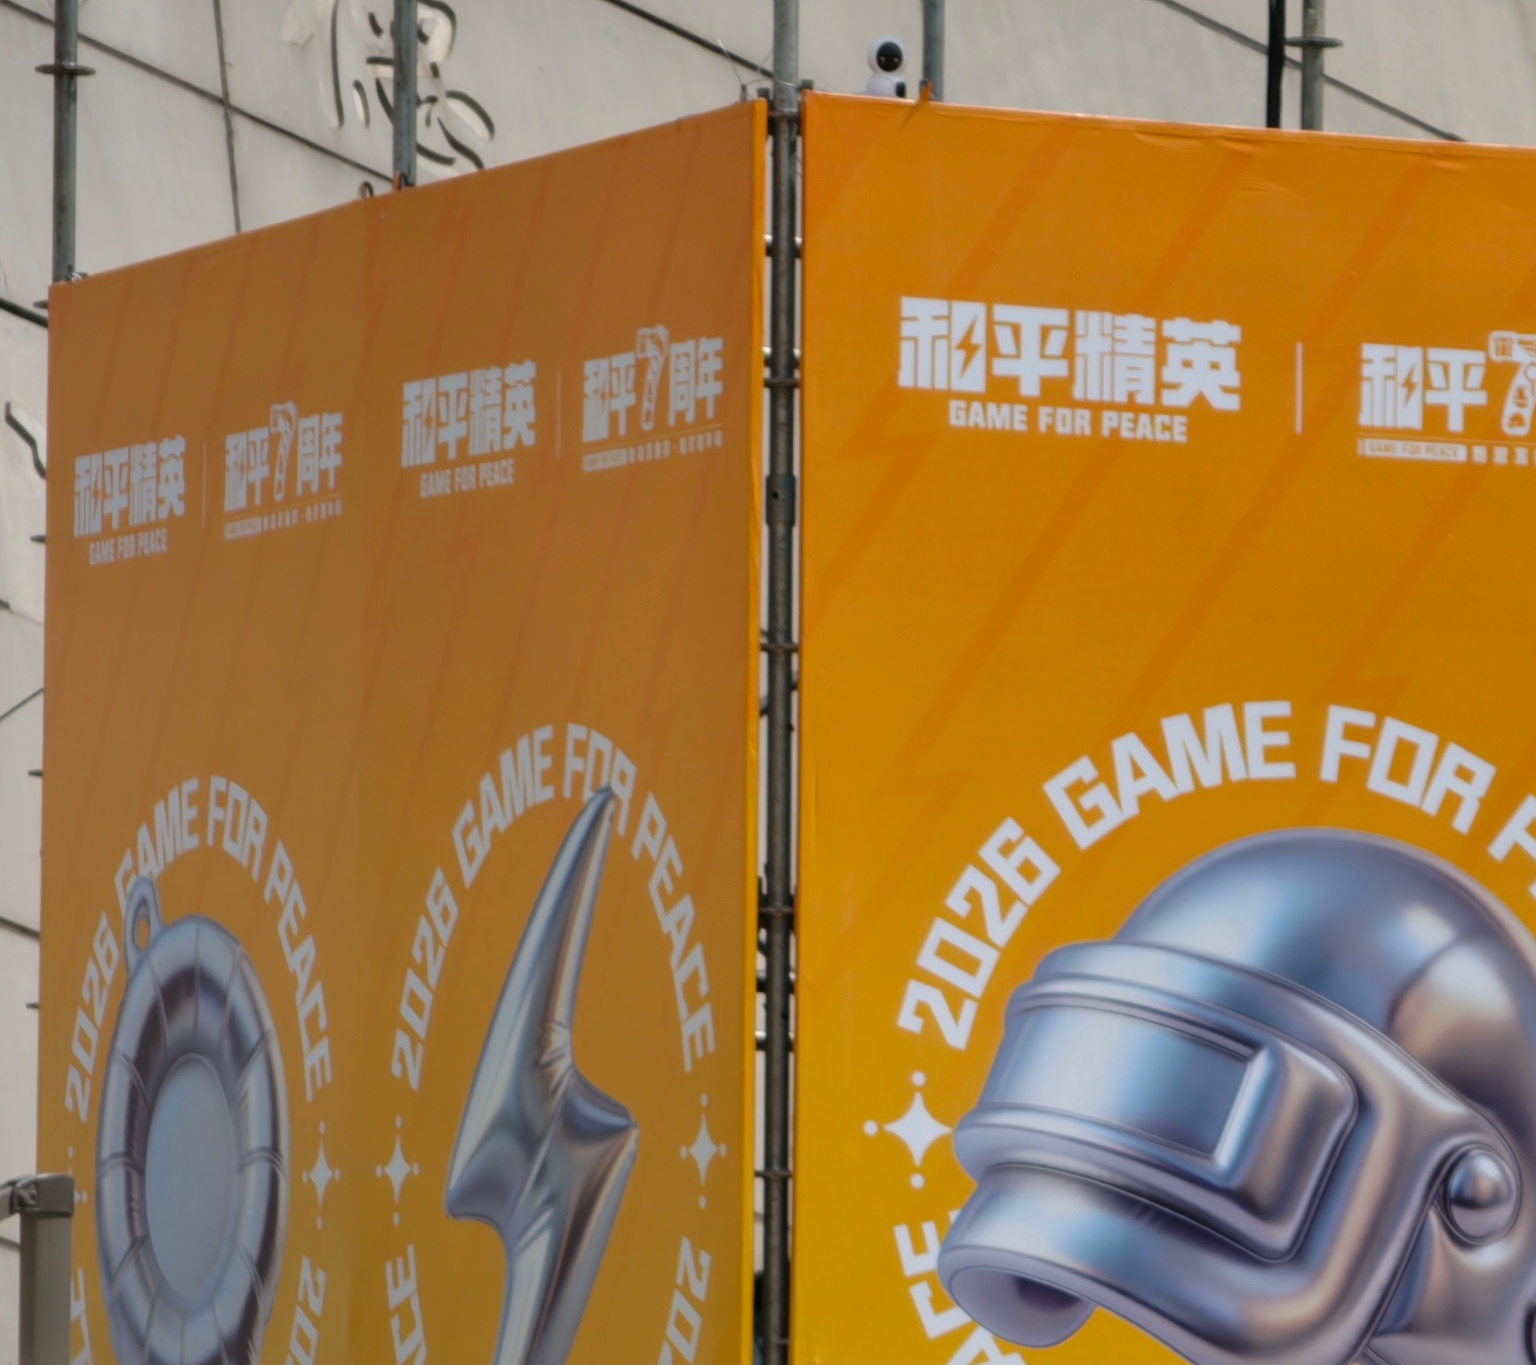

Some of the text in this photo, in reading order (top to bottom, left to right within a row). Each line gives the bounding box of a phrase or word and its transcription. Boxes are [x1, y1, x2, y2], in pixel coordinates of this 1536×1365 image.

[582, 324, 724, 443] 和平7周年
[898, 296, 1242, 412] 和平精英
[224, 400, 343, 513] 和平7周年
[401, 359, 536, 469] 和平精英
[949, 400, 1189, 443] GAME FOR PEACE
[73, 435, 186, 538] 和平精英
[420, 458, 514, 499] GAME FOR PEACE
[88, 527, 167, 566] GAME FOR PEACE
[392, 722, 716, 1091] 2026 GAME FOR PEACE
[897, 817, 1061, 1051] 2026
[1043, 701, 1296, 850] GAME
[1320, 704, 1497, 834] FOR
[64, 774, 333, 1124] 2026 GAME FOR PEACE
